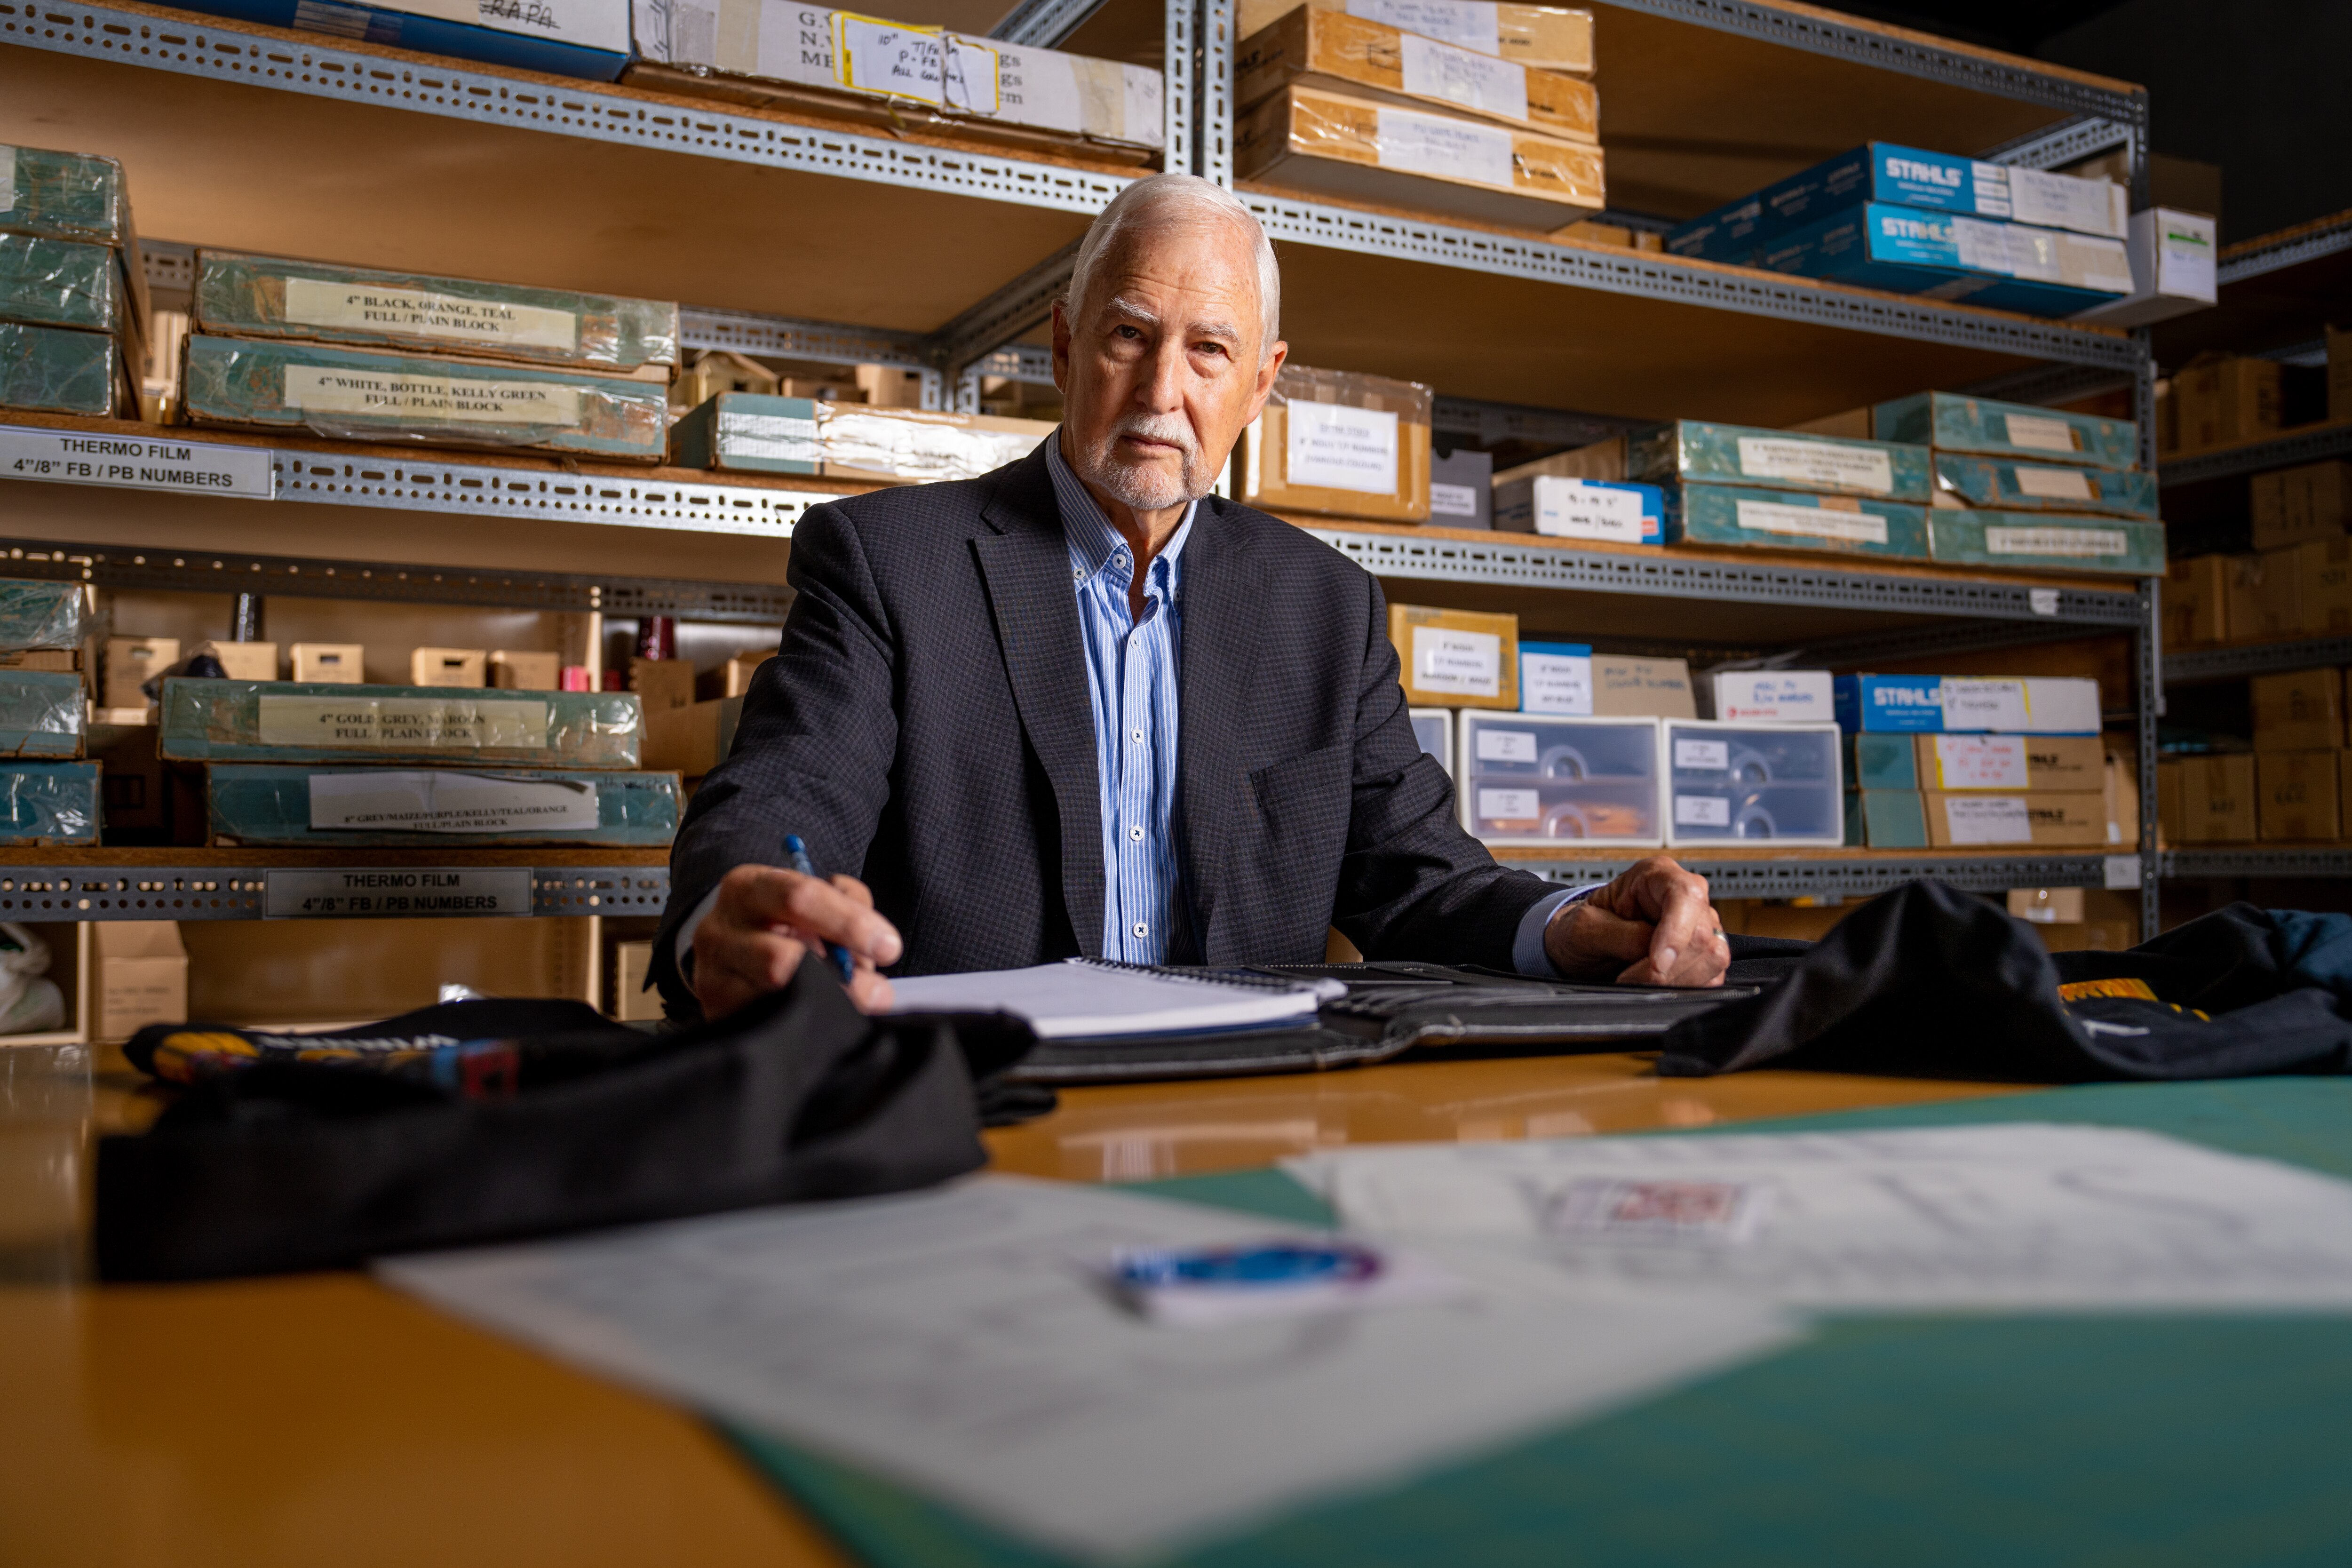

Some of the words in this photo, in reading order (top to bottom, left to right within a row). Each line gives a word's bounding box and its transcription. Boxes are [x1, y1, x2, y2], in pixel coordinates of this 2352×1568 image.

[364, 296, 416, 310] BLACK,
[419, 301, 477, 317] ORANGE,
[481, 307, 516, 320] TEAL
[364, 311, 401, 323] FULL
[403, 313, 408, 323] /
[411, 313, 449, 326] PLAIN
[453, 317, 500, 332] BLOCK
[335, 378, 387, 392] WHITE,
[452, 386, 496, 399] KELLY
[500, 388, 546, 400] GREEN
[365, 394, 402, 406] FULL
[412, 397, 453, 409] PLAIN
[456, 400, 503, 412] BLOCK
[60, 438, 142, 456] THERMO
[149, 446, 191, 461] FILM
[67, 462, 91, 477] FB
[97, 464, 103, 478] /
[109, 465, 134, 479] PB
[141, 468, 233, 487] NUMBERS
[335, 728, 372, 739] FULL
[381, 728, 423, 740] PLAIN
[474, 818, 508, 827] BLOCK
[343, 874, 417, 888] THERMO
[422, 874, 460, 887] FILM
[349, 897, 372, 911] FB
[375, 897, 381, 910] /
[386, 896, 410, 910] PB
[414, 895, 498, 909] NUMBERS
